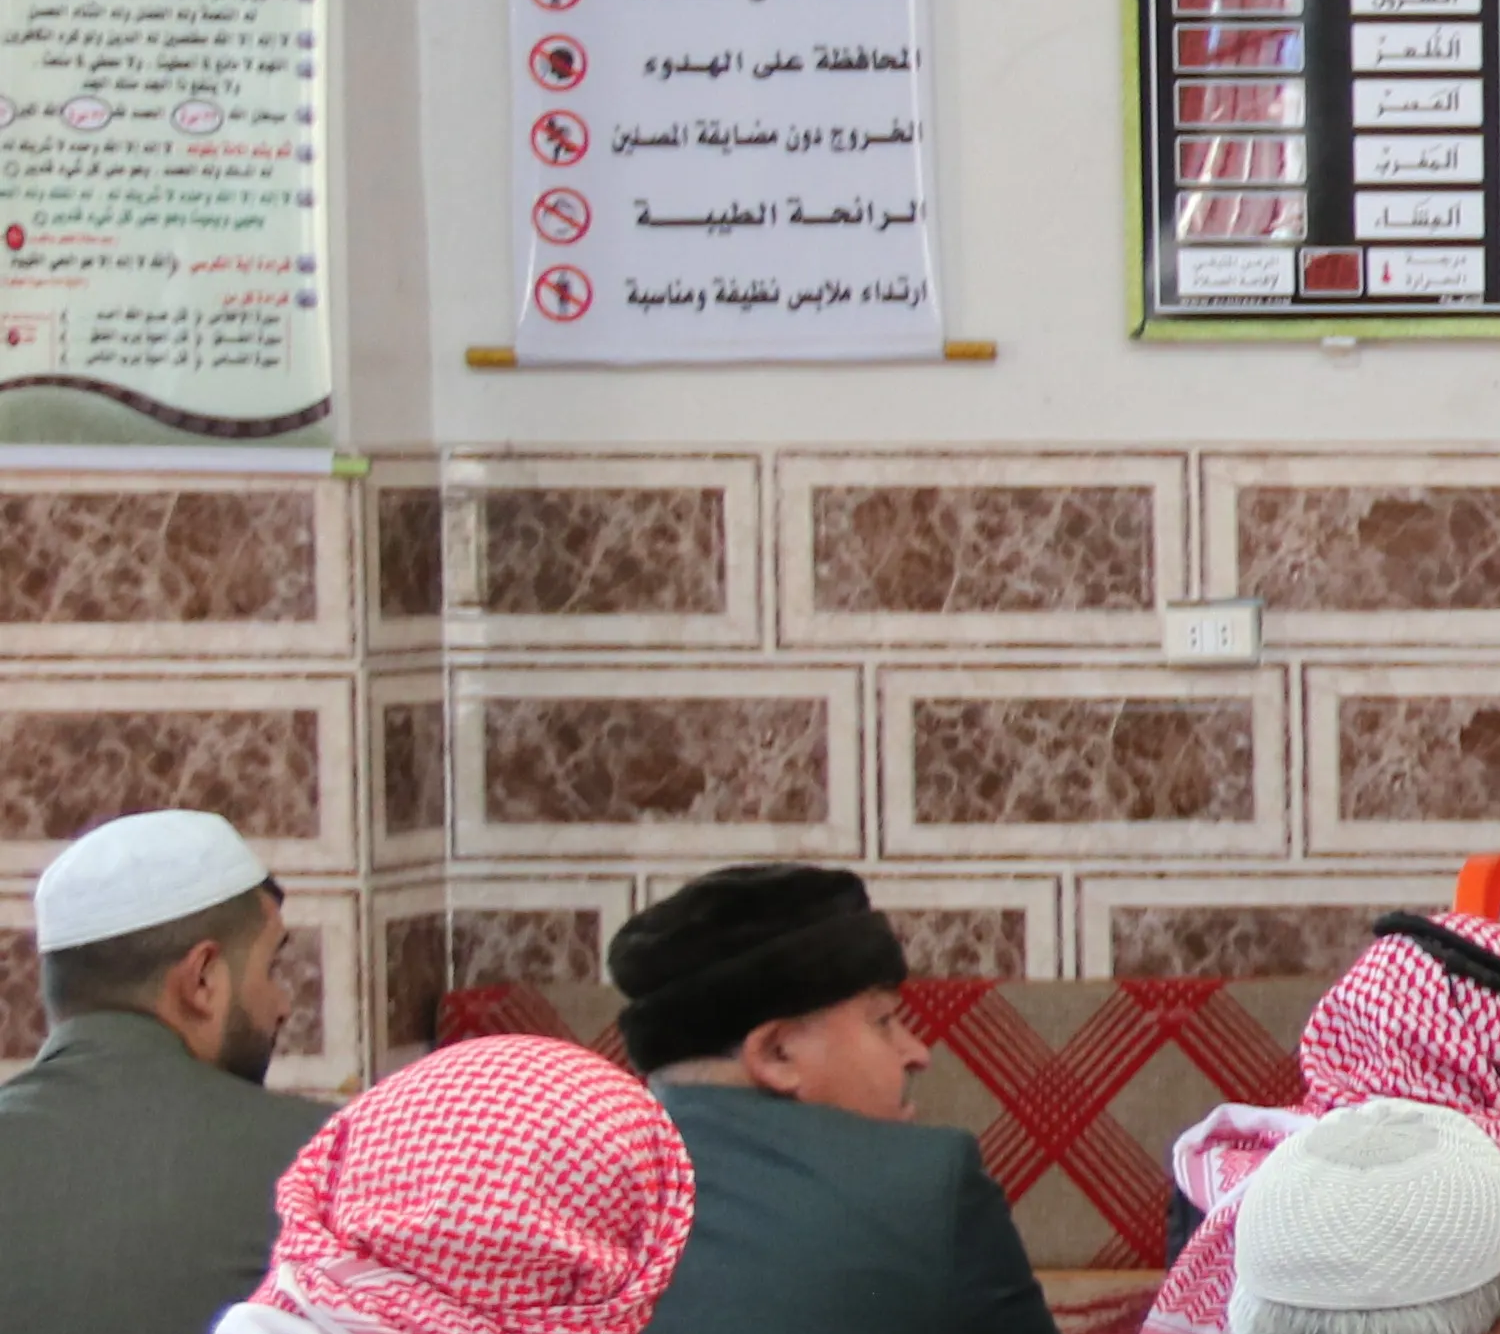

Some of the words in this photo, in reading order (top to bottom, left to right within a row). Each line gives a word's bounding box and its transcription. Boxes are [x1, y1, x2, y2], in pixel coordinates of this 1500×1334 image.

[642, 47, 743, 80] الهدوء
[752, 49, 804, 79] على
[813, 44, 921, 73] المحافظة
[611, 120, 688, 156] المصلين
[695, 118, 778, 155] مضايقة
[784, 125, 824, 154] دون
[830, 117, 923, 151] الخروج
[633, 198, 778, 237] الطيبة
[625, 276, 707, 314] ومناسبة
[713, 275, 781, 313] نظيفة
[787, 278, 852, 313] ملابس
[859, 276, 928, 308] ارتداء
